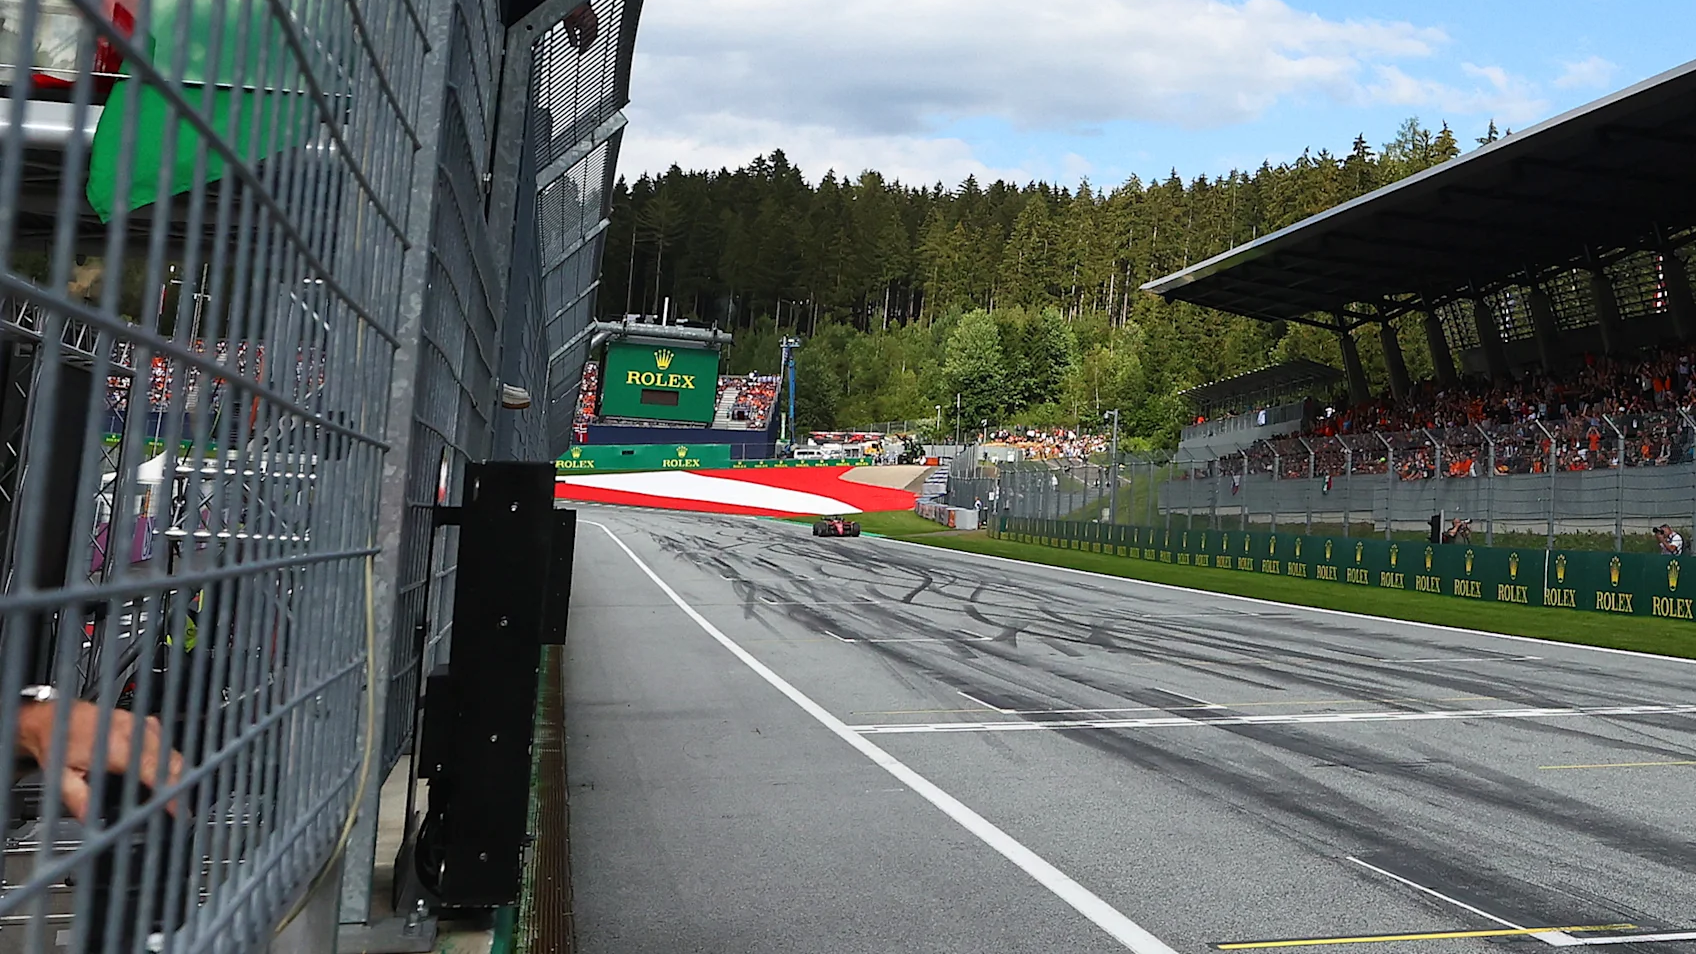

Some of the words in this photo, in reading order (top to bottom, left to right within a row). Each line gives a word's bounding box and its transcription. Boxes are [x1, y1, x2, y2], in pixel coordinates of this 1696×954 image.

[626, 370, 696, 389] ROLEX
[555, 459, 595, 469] ROLEX
[662, 459, 700, 467] ROLEX
[1316, 564, 1338, 581] ROLEX
[1346, 567, 1369, 585] ROLEX
[1380, 570, 1405, 589] ROLEX
[1415, 574, 1441, 593] ROLEX
[1454, 578, 1482, 598] ROLEX
[1497, 583, 1528, 603] ROLEX
[1544, 587, 1576, 608] ROLEX
[1596, 591, 1633, 613] ROLEX
[1652, 596, 1694, 620] ROLEX
